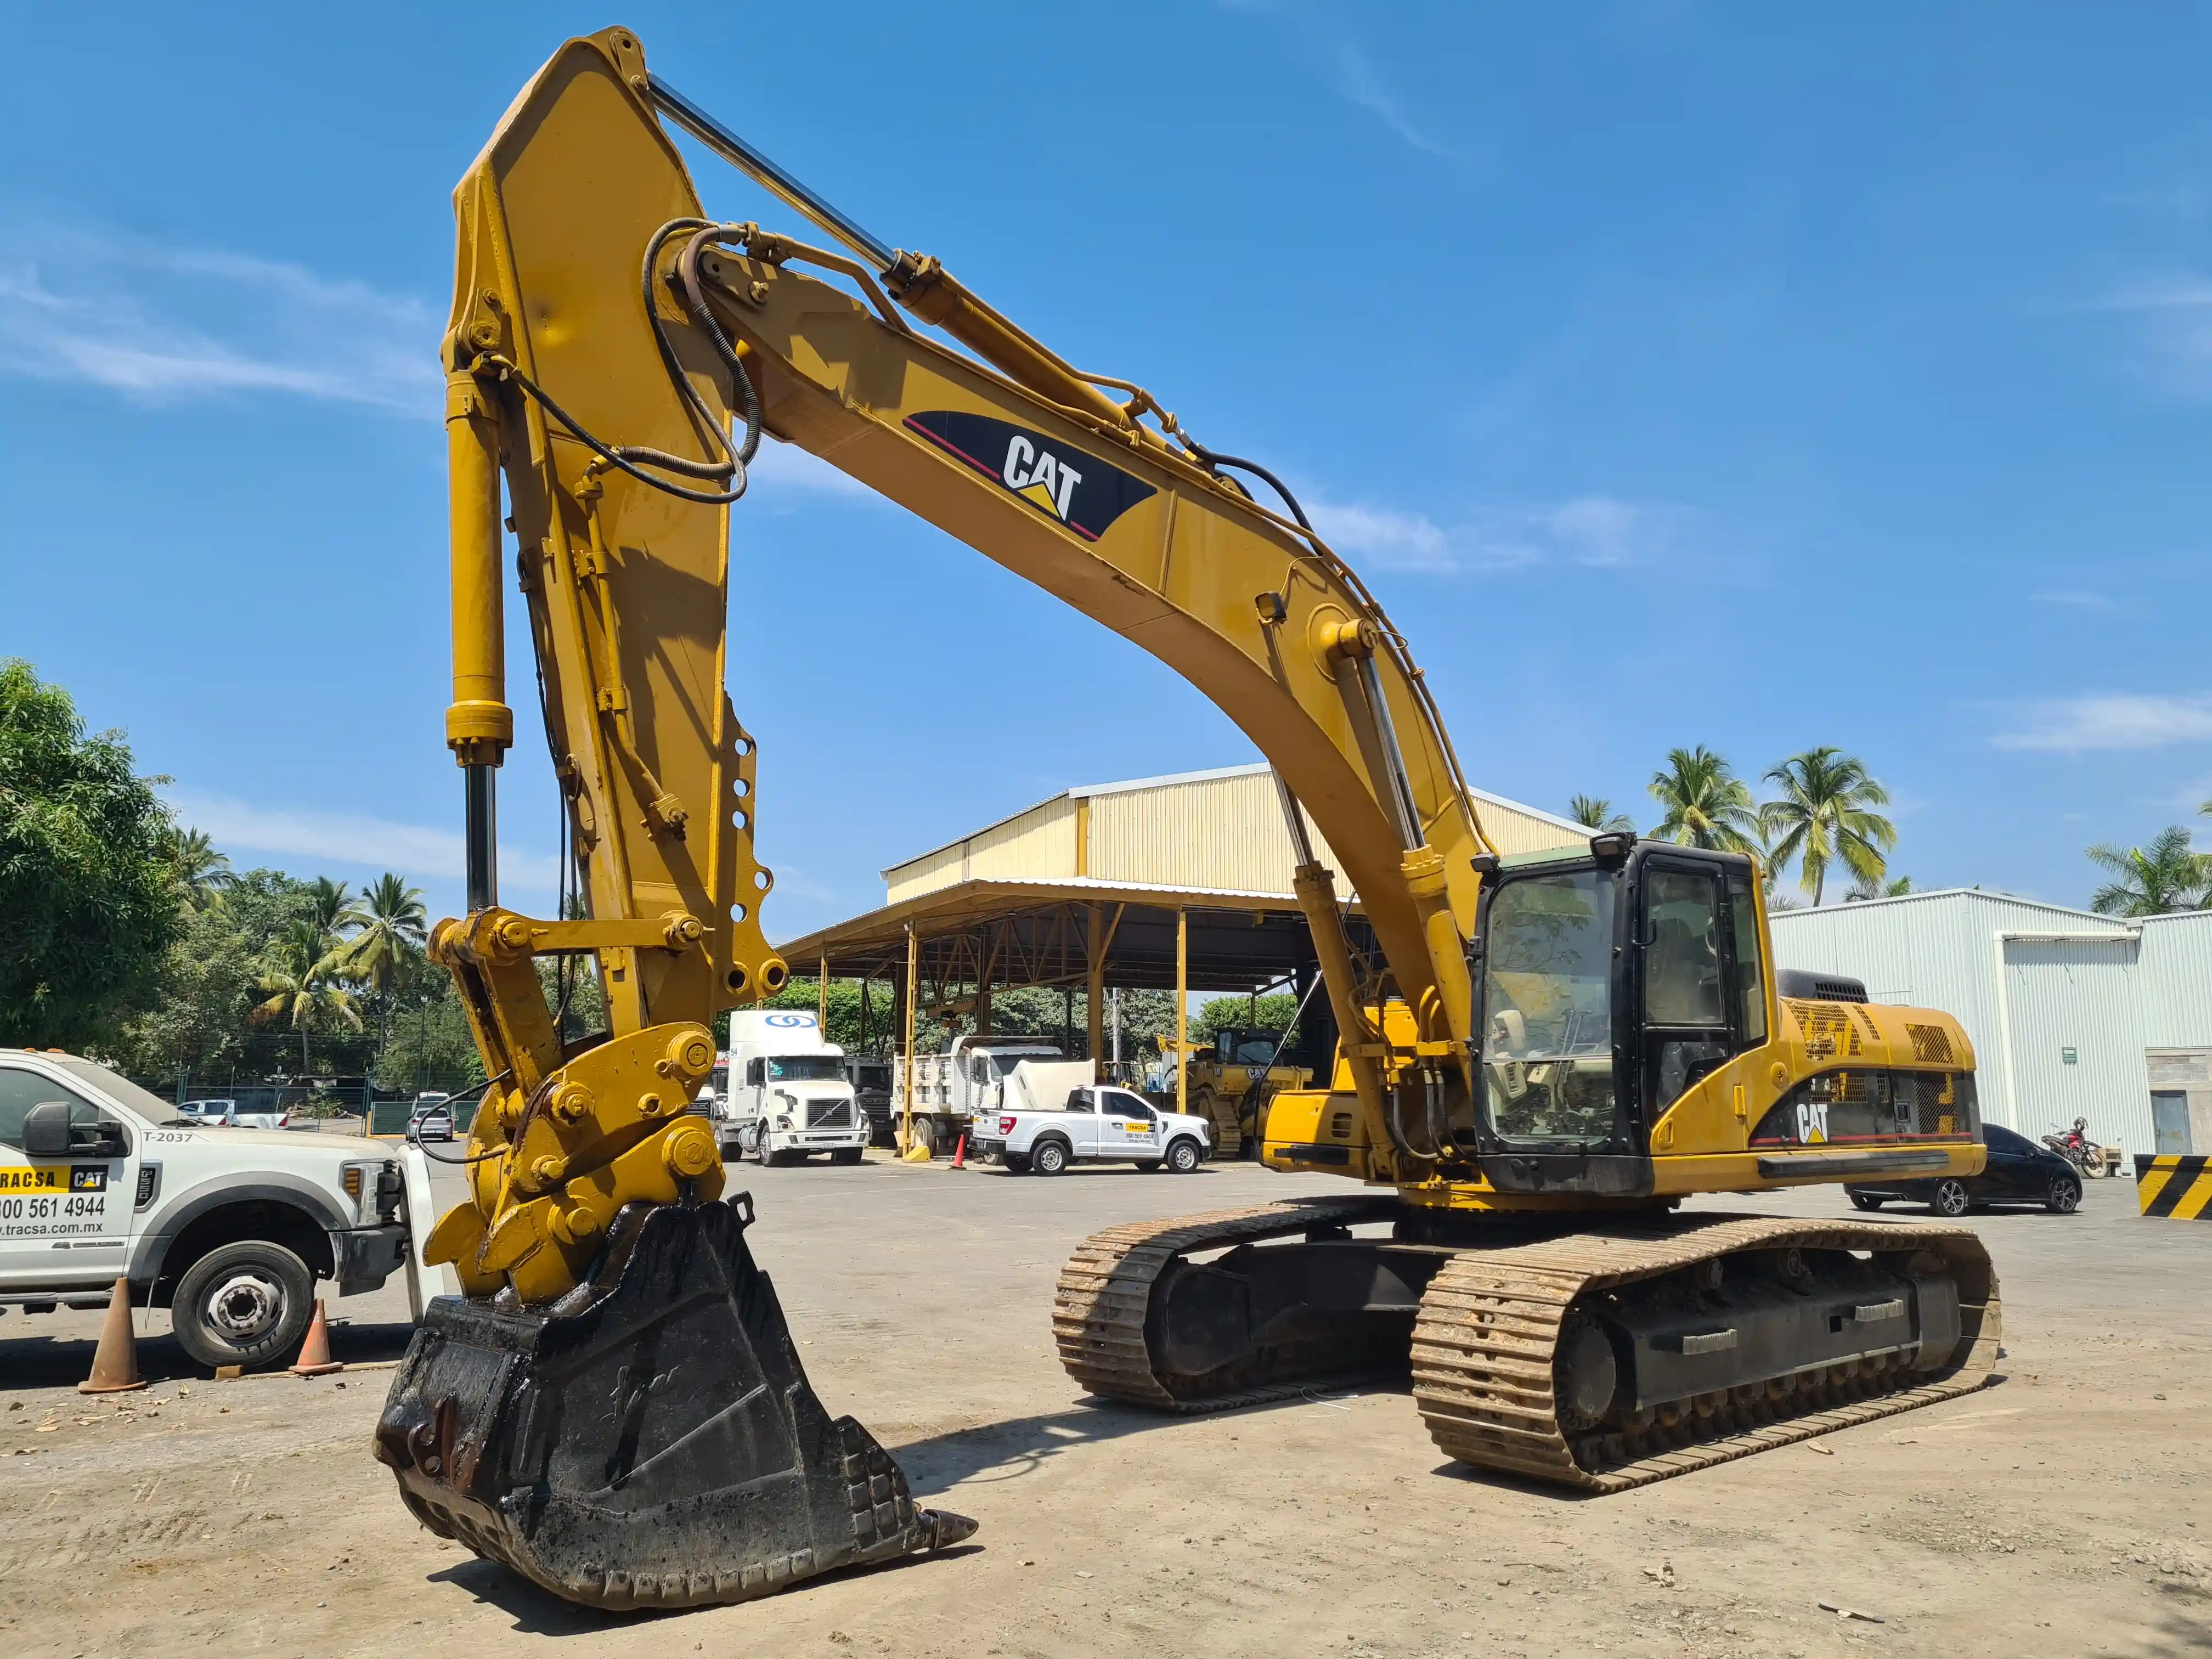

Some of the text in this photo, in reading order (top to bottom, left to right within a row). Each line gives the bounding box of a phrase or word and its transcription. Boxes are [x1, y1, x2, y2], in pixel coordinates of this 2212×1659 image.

[1003, 435, 1082, 521] CAT
[1797, 1104, 1828, 1143] CAT
[144, 1132, 193, 1143] T-2037
[74, 1172, 106, 1187] CAT
[0, 1197, 105, 1219] 00 561 4944
